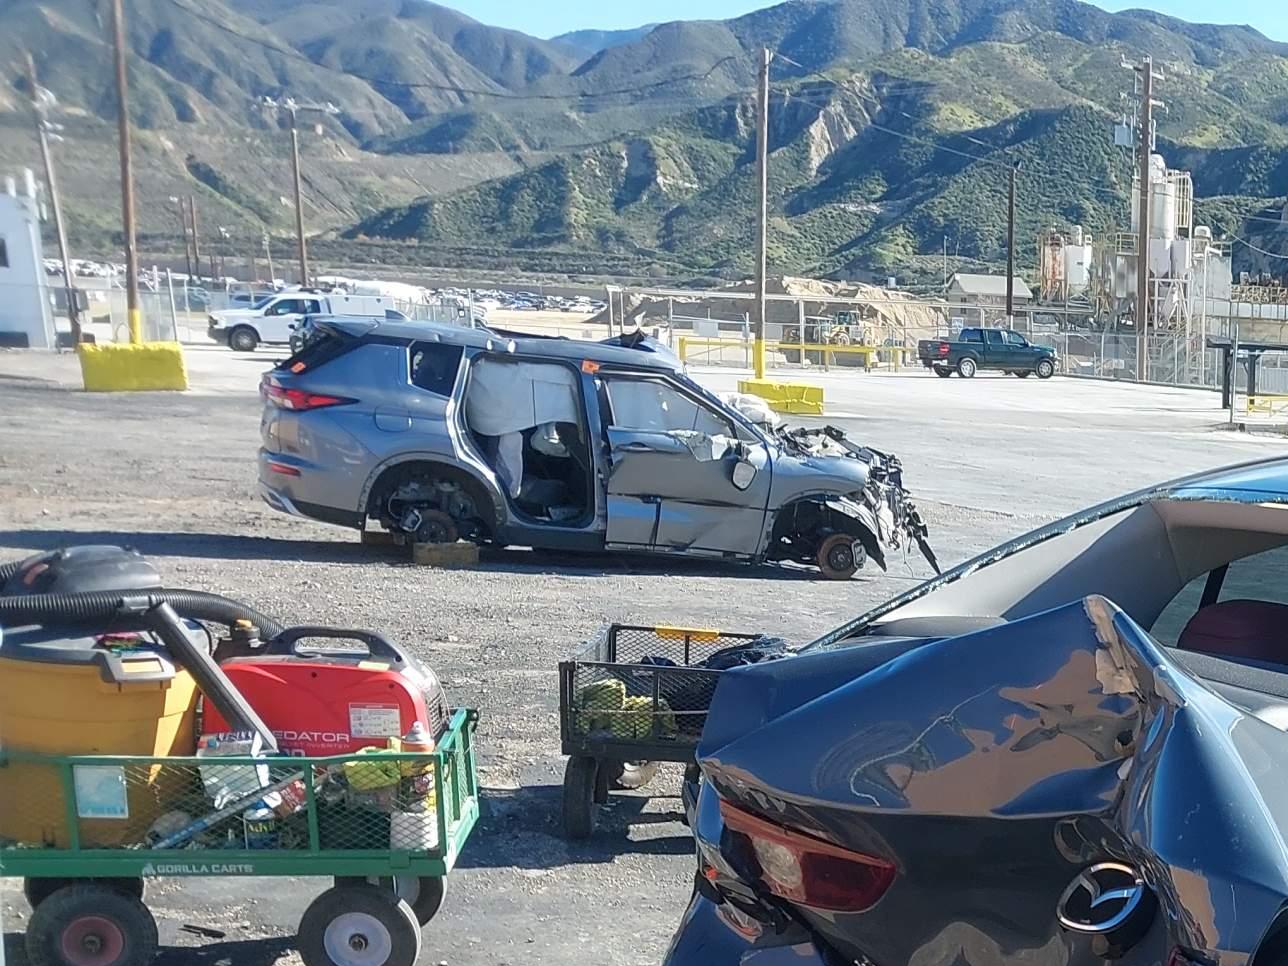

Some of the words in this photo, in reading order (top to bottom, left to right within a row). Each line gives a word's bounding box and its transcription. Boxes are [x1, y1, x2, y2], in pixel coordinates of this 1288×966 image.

[272, 730, 350, 743] EDATOR
[156, 864, 209, 874] GORILLA
[211, 864, 254, 874] CARTS
